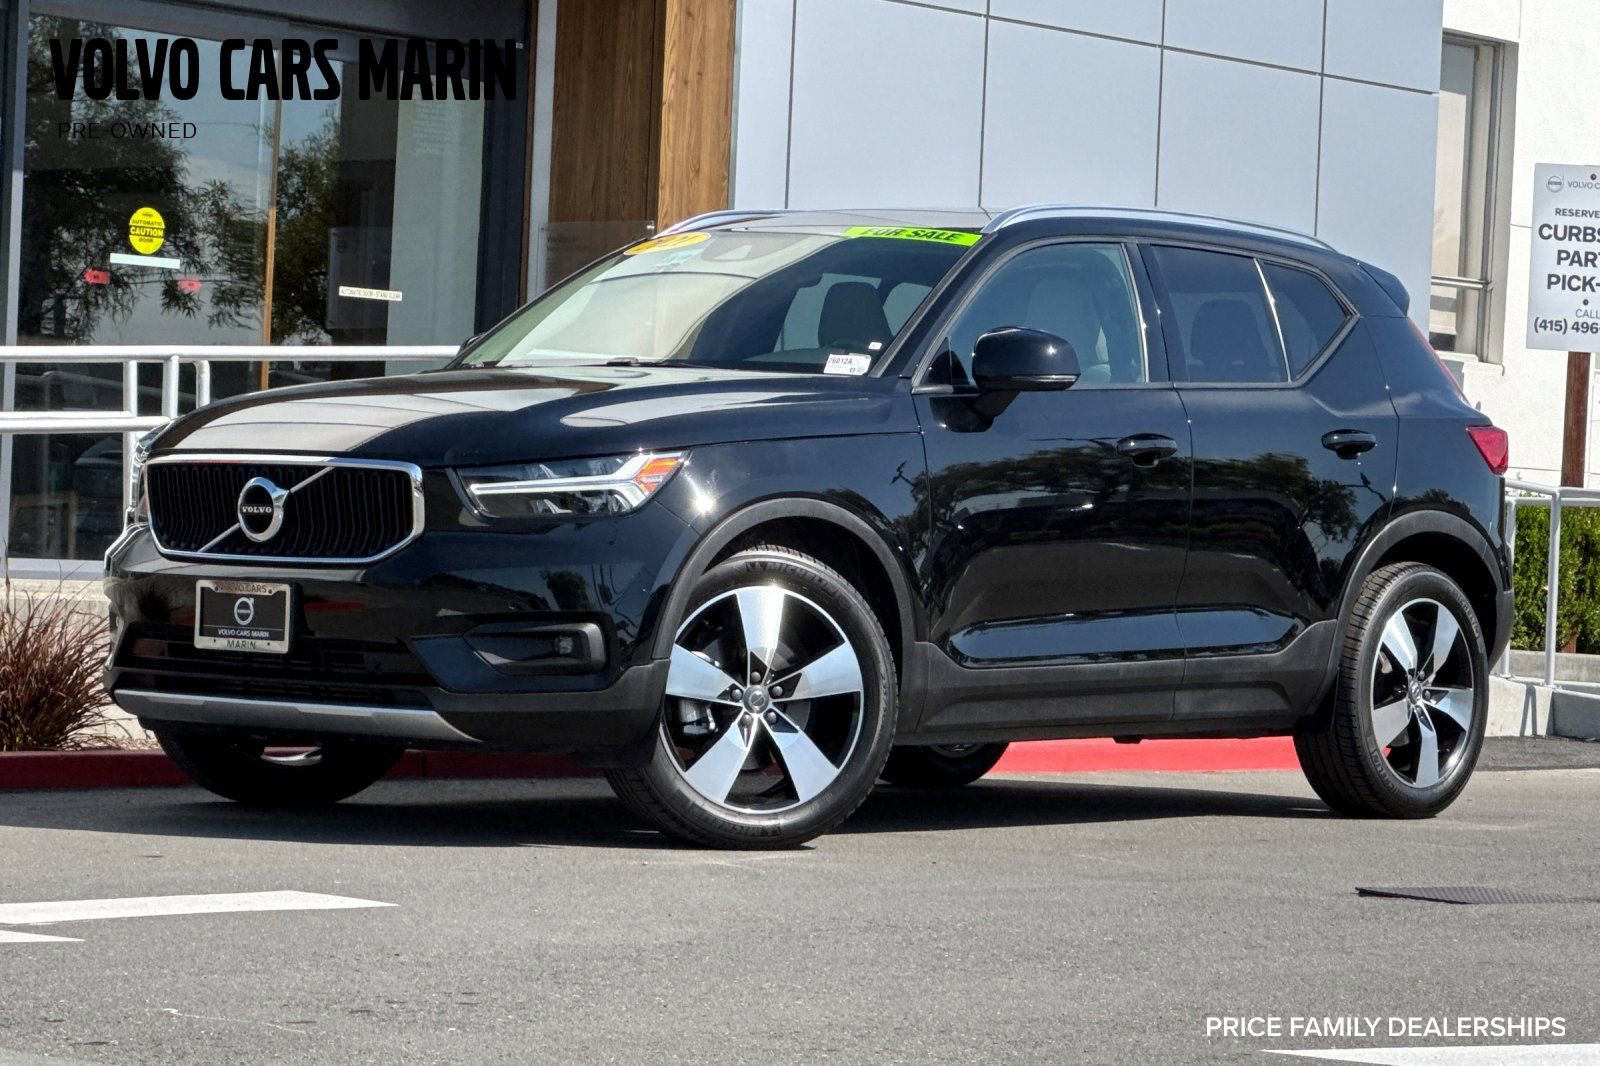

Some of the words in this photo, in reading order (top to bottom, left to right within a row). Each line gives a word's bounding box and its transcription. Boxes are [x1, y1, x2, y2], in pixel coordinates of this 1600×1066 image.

[1567, 181, 1594, 189] VOLVO
[130, 227, 164, 237] CAUTION
[907, 229, 962, 240] SALE
[1556, 249, 1600, 268] PAR
[1534, 316, 1568, 335] (415)
[242, 505, 273, 514] VOLVO
[227, 640, 256, 650] MARIN
